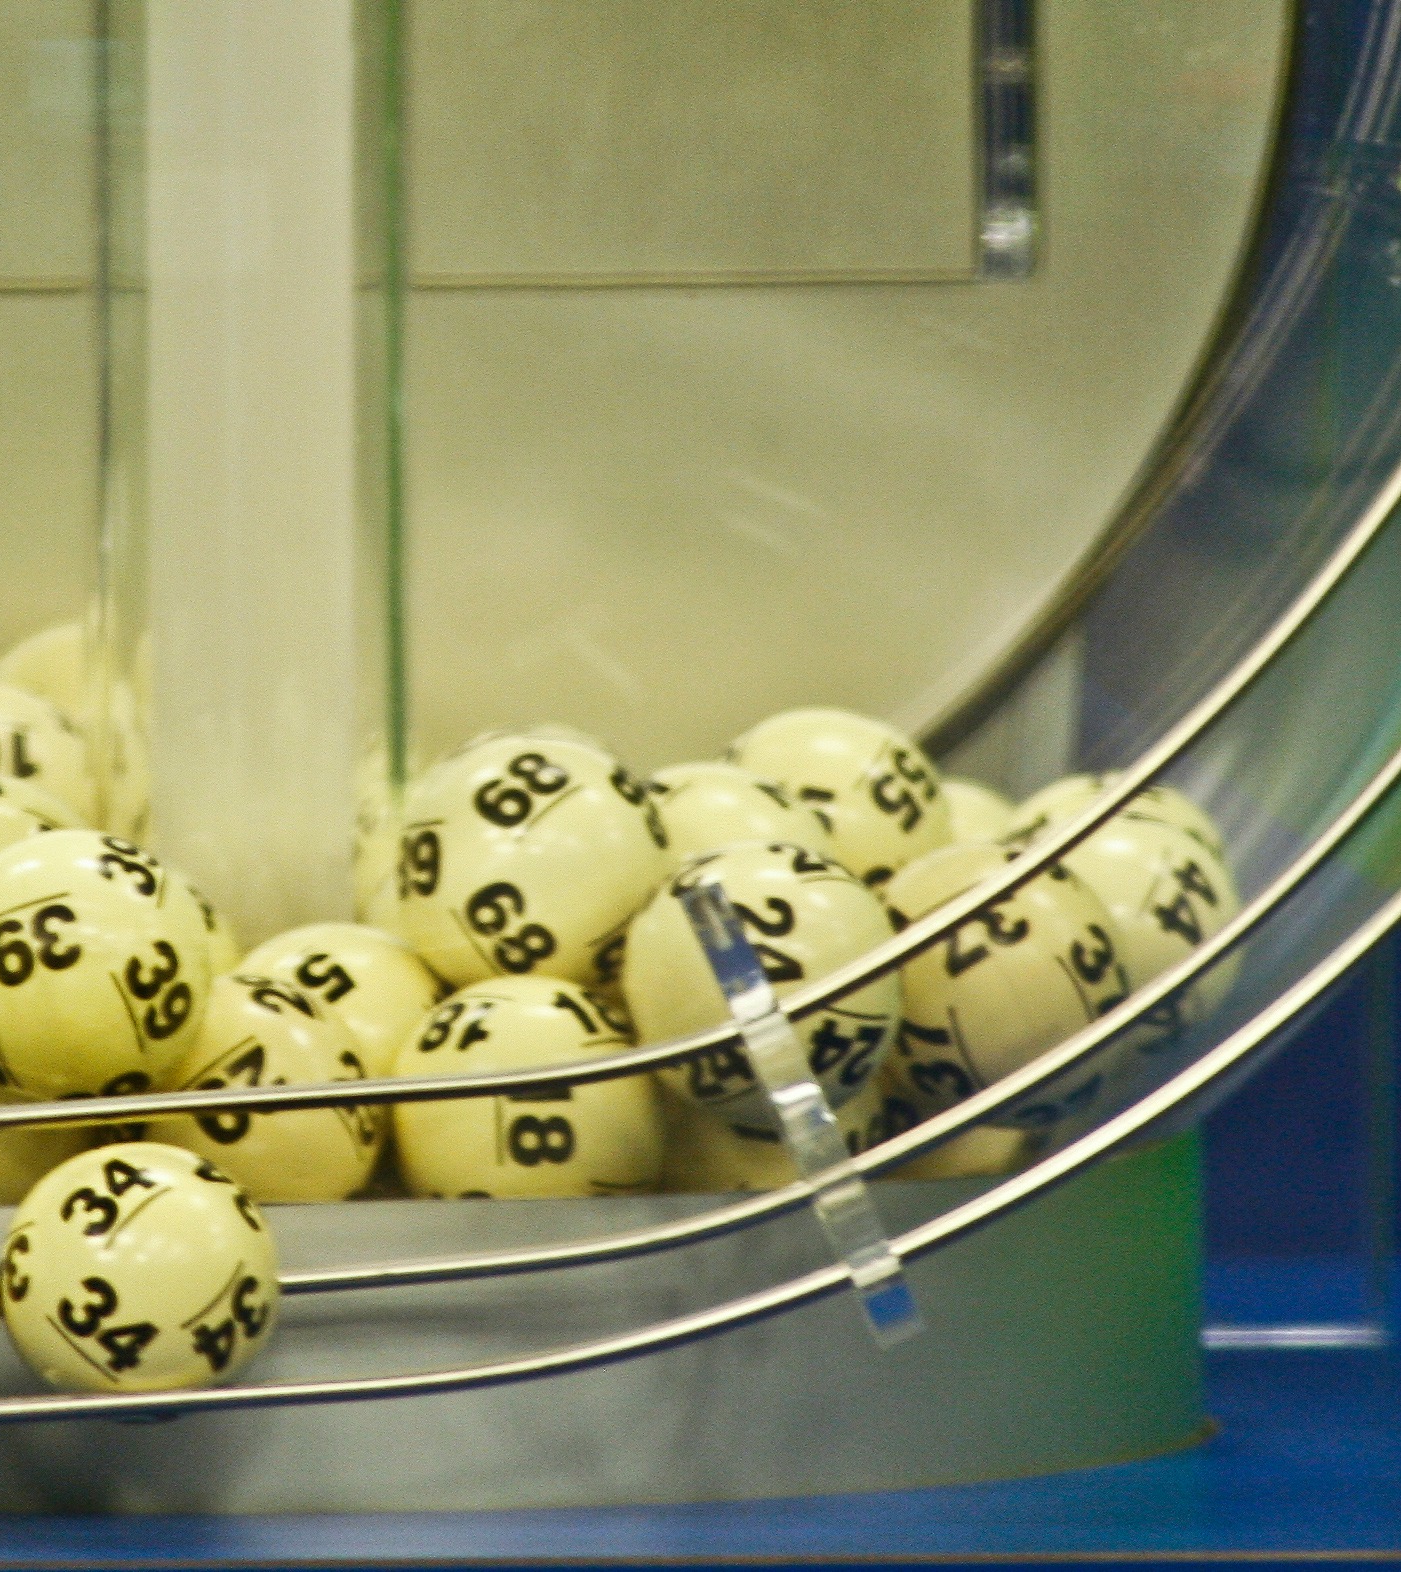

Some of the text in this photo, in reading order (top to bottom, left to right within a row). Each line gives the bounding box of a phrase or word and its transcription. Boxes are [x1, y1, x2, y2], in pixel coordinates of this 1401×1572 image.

[473, 752, 569, 828] 68
[99, 836, 158, 898] 39
[1153, 860, 1219, 947] 44
[466, 881, 558, 974] 68
[124, 940, 193, 1040] 39
[417, 1001, 491, 1053] 18
[809, 1017, 886, 1088] 24
[61, 1158, 155, 1237] 34
[4, 1234, 31, 1302] 3
[57, 1276, 161, 1372] 34
[191, 1276, 272, 1373] 34
